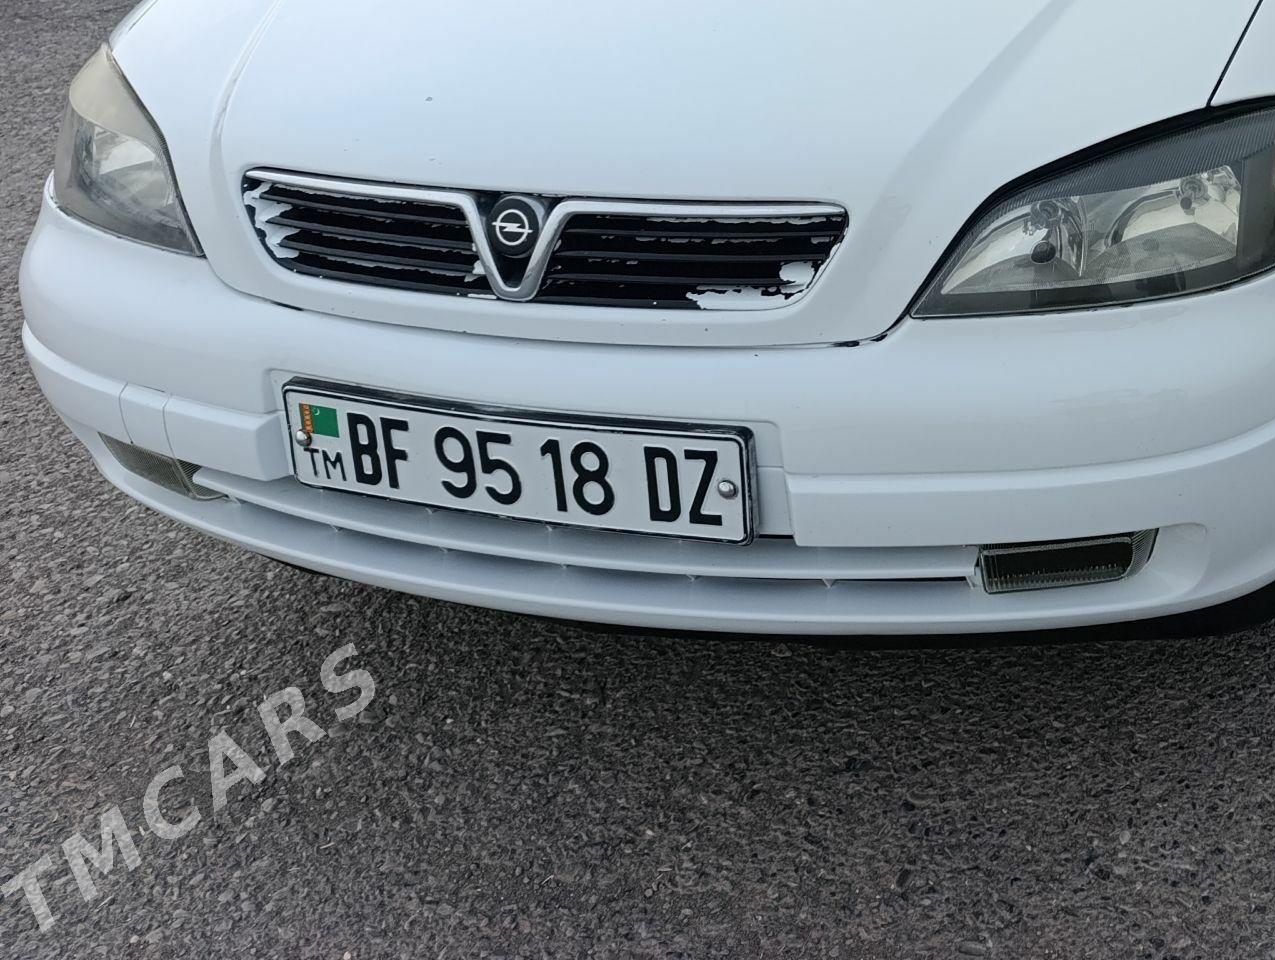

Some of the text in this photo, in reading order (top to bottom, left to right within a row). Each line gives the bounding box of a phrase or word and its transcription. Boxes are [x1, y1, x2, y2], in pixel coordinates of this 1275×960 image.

[303, 447, 347, 482] TM
[346, 411, 723, 526] BF 95 18 DZ
